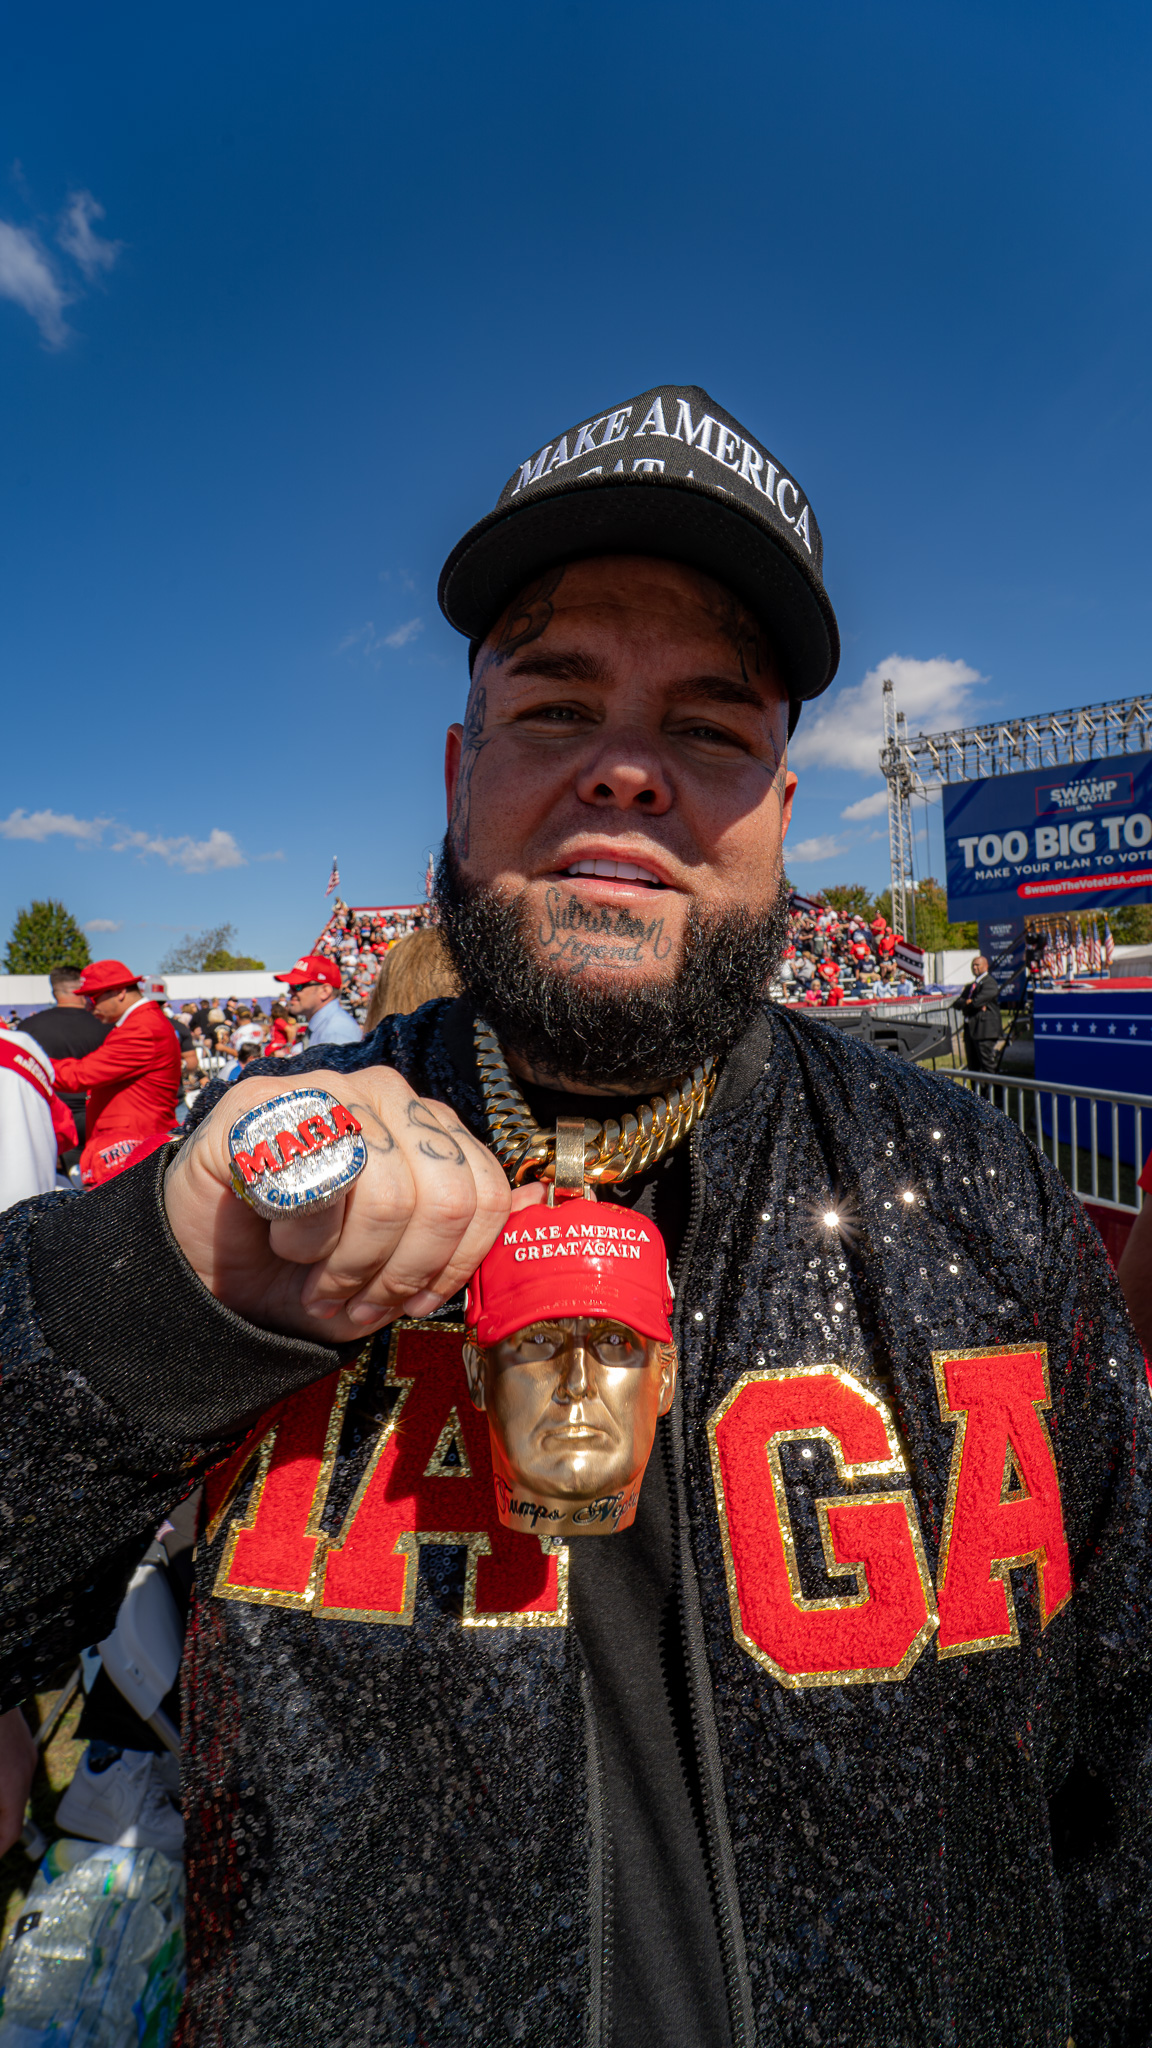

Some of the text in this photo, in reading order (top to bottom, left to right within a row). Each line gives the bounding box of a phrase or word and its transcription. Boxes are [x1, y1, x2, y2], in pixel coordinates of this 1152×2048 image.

[511, 396, 812, 555] MAKE AMERICA
[1049, 780, 1118, 802] SWAMP
[1057, 791, 1112, 808] THE VOTE
[1075, 804, 1093, 813] USA
[957, 812, 1152, 870] TOO BIG TO
[974, 866, 1011, 881] MAKE
[1014, 862, 1050, 876] YOUR
[1054, 857, 1091, 872] PLAN
[1095, 854, 1114, 867] TO
[234, 1104, 363, 1184] MAGA
[503, 1224, 651, 1246] MAKE AMERICA
[514, 1241, 641, 1262] GREAT AGAIN
